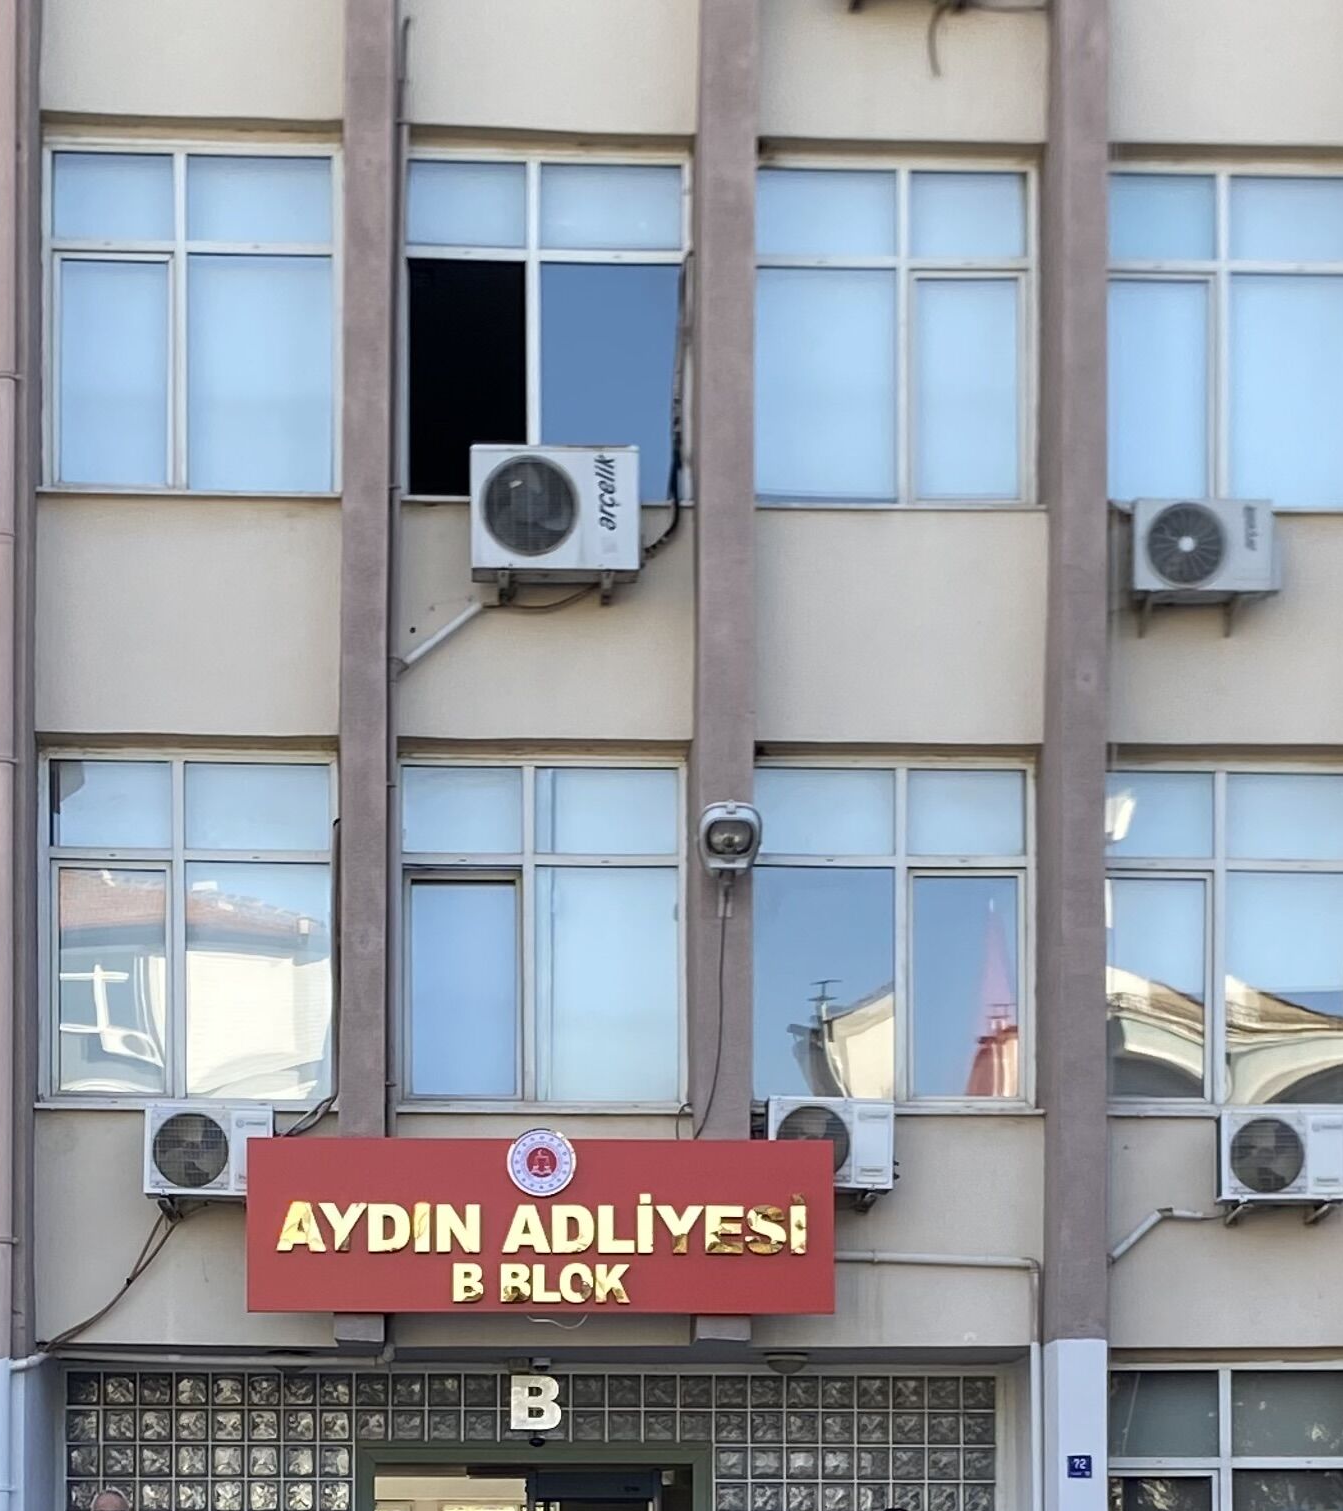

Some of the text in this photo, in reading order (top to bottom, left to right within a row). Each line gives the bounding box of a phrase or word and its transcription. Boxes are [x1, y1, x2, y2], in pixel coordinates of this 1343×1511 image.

[276, 1193, 808, 1256] AYDIN ADLİYESİ
[452, 1263, 631, 1304] B BLOK
[510, 1375, 562, 1430] B
[1073, 1458, 1086, 1470] 72
